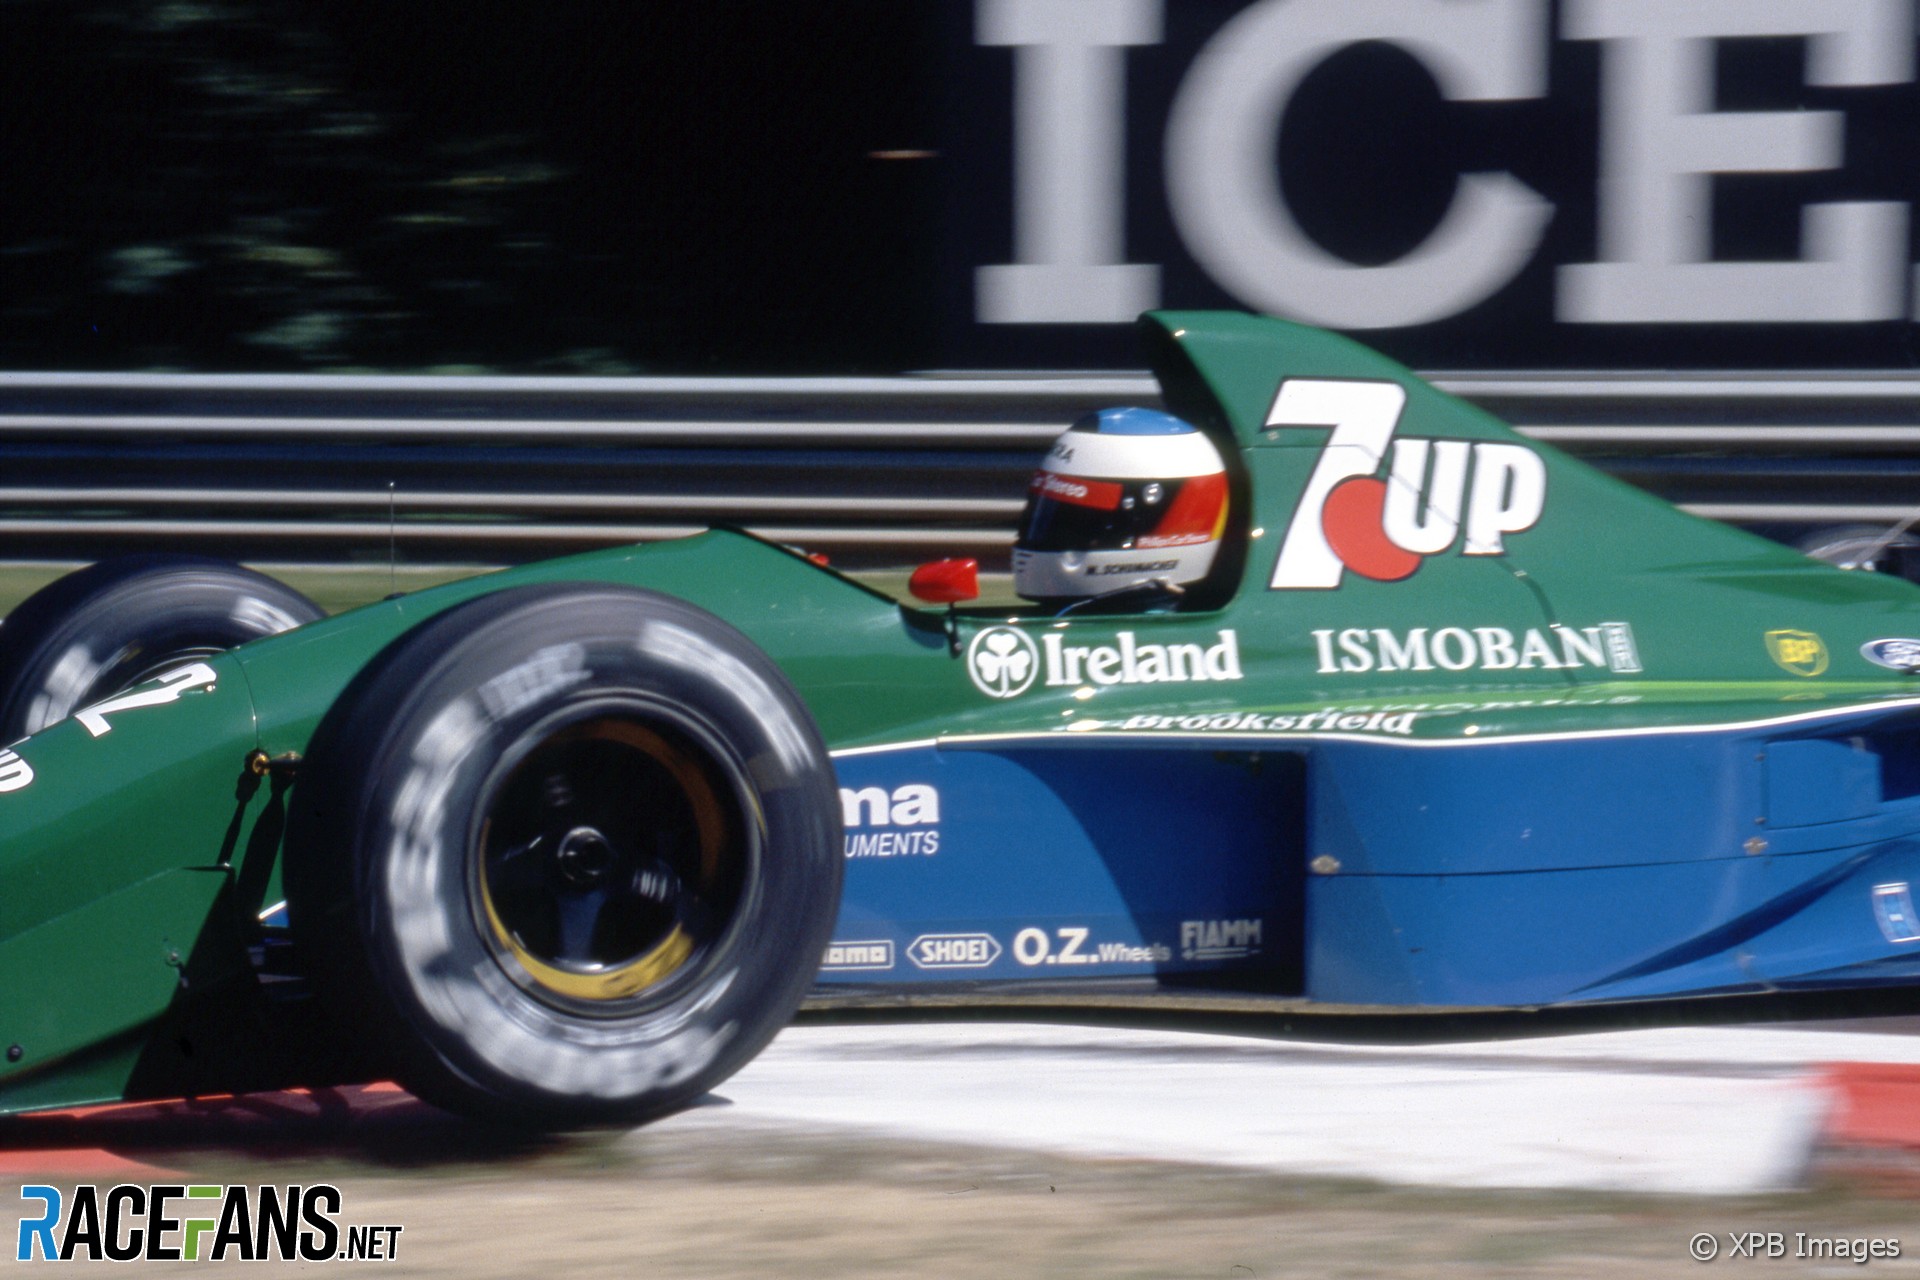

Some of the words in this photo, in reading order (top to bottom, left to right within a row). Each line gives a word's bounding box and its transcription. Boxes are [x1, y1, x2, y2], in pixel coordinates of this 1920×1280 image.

[974, 0, 1920, 328] ICE
[1042, 629, 1244, 686] Ireland
[1311, 627, 1608, 673] ISMOBAN
[1121, 710, 1417, 735] Brooksfield
[838, 783, 940, 826] ma
[844, 830, 940, 858] UMENTS
[1180, 919, 1262, 949] FIAMM
[821, 945, 887, 964] omo
[919, 939, 989, 962] SHOEI
[1099, 942, 1171, 962] Wheels
